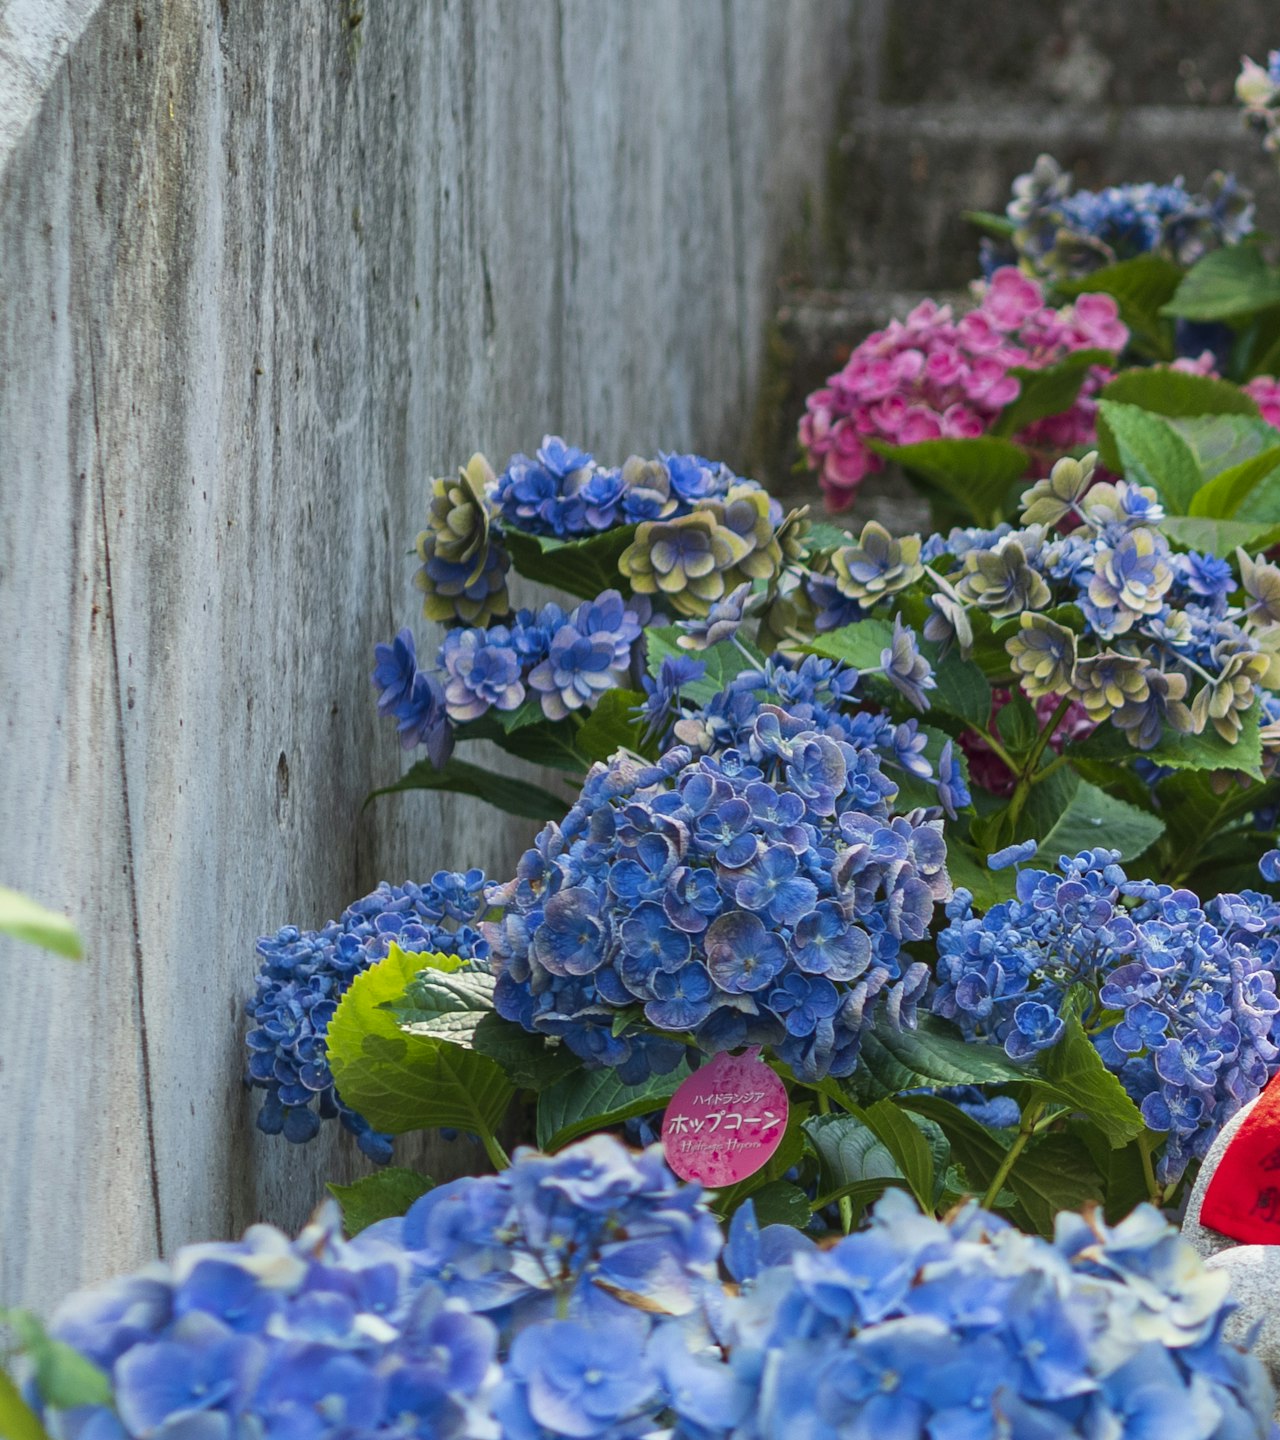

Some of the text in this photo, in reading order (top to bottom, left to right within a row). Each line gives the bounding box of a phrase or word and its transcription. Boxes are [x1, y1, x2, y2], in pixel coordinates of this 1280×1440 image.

[692, 1092, 765, 1106] ハイドランジア
[668, 1109, 782, 1134] ホップコーン
